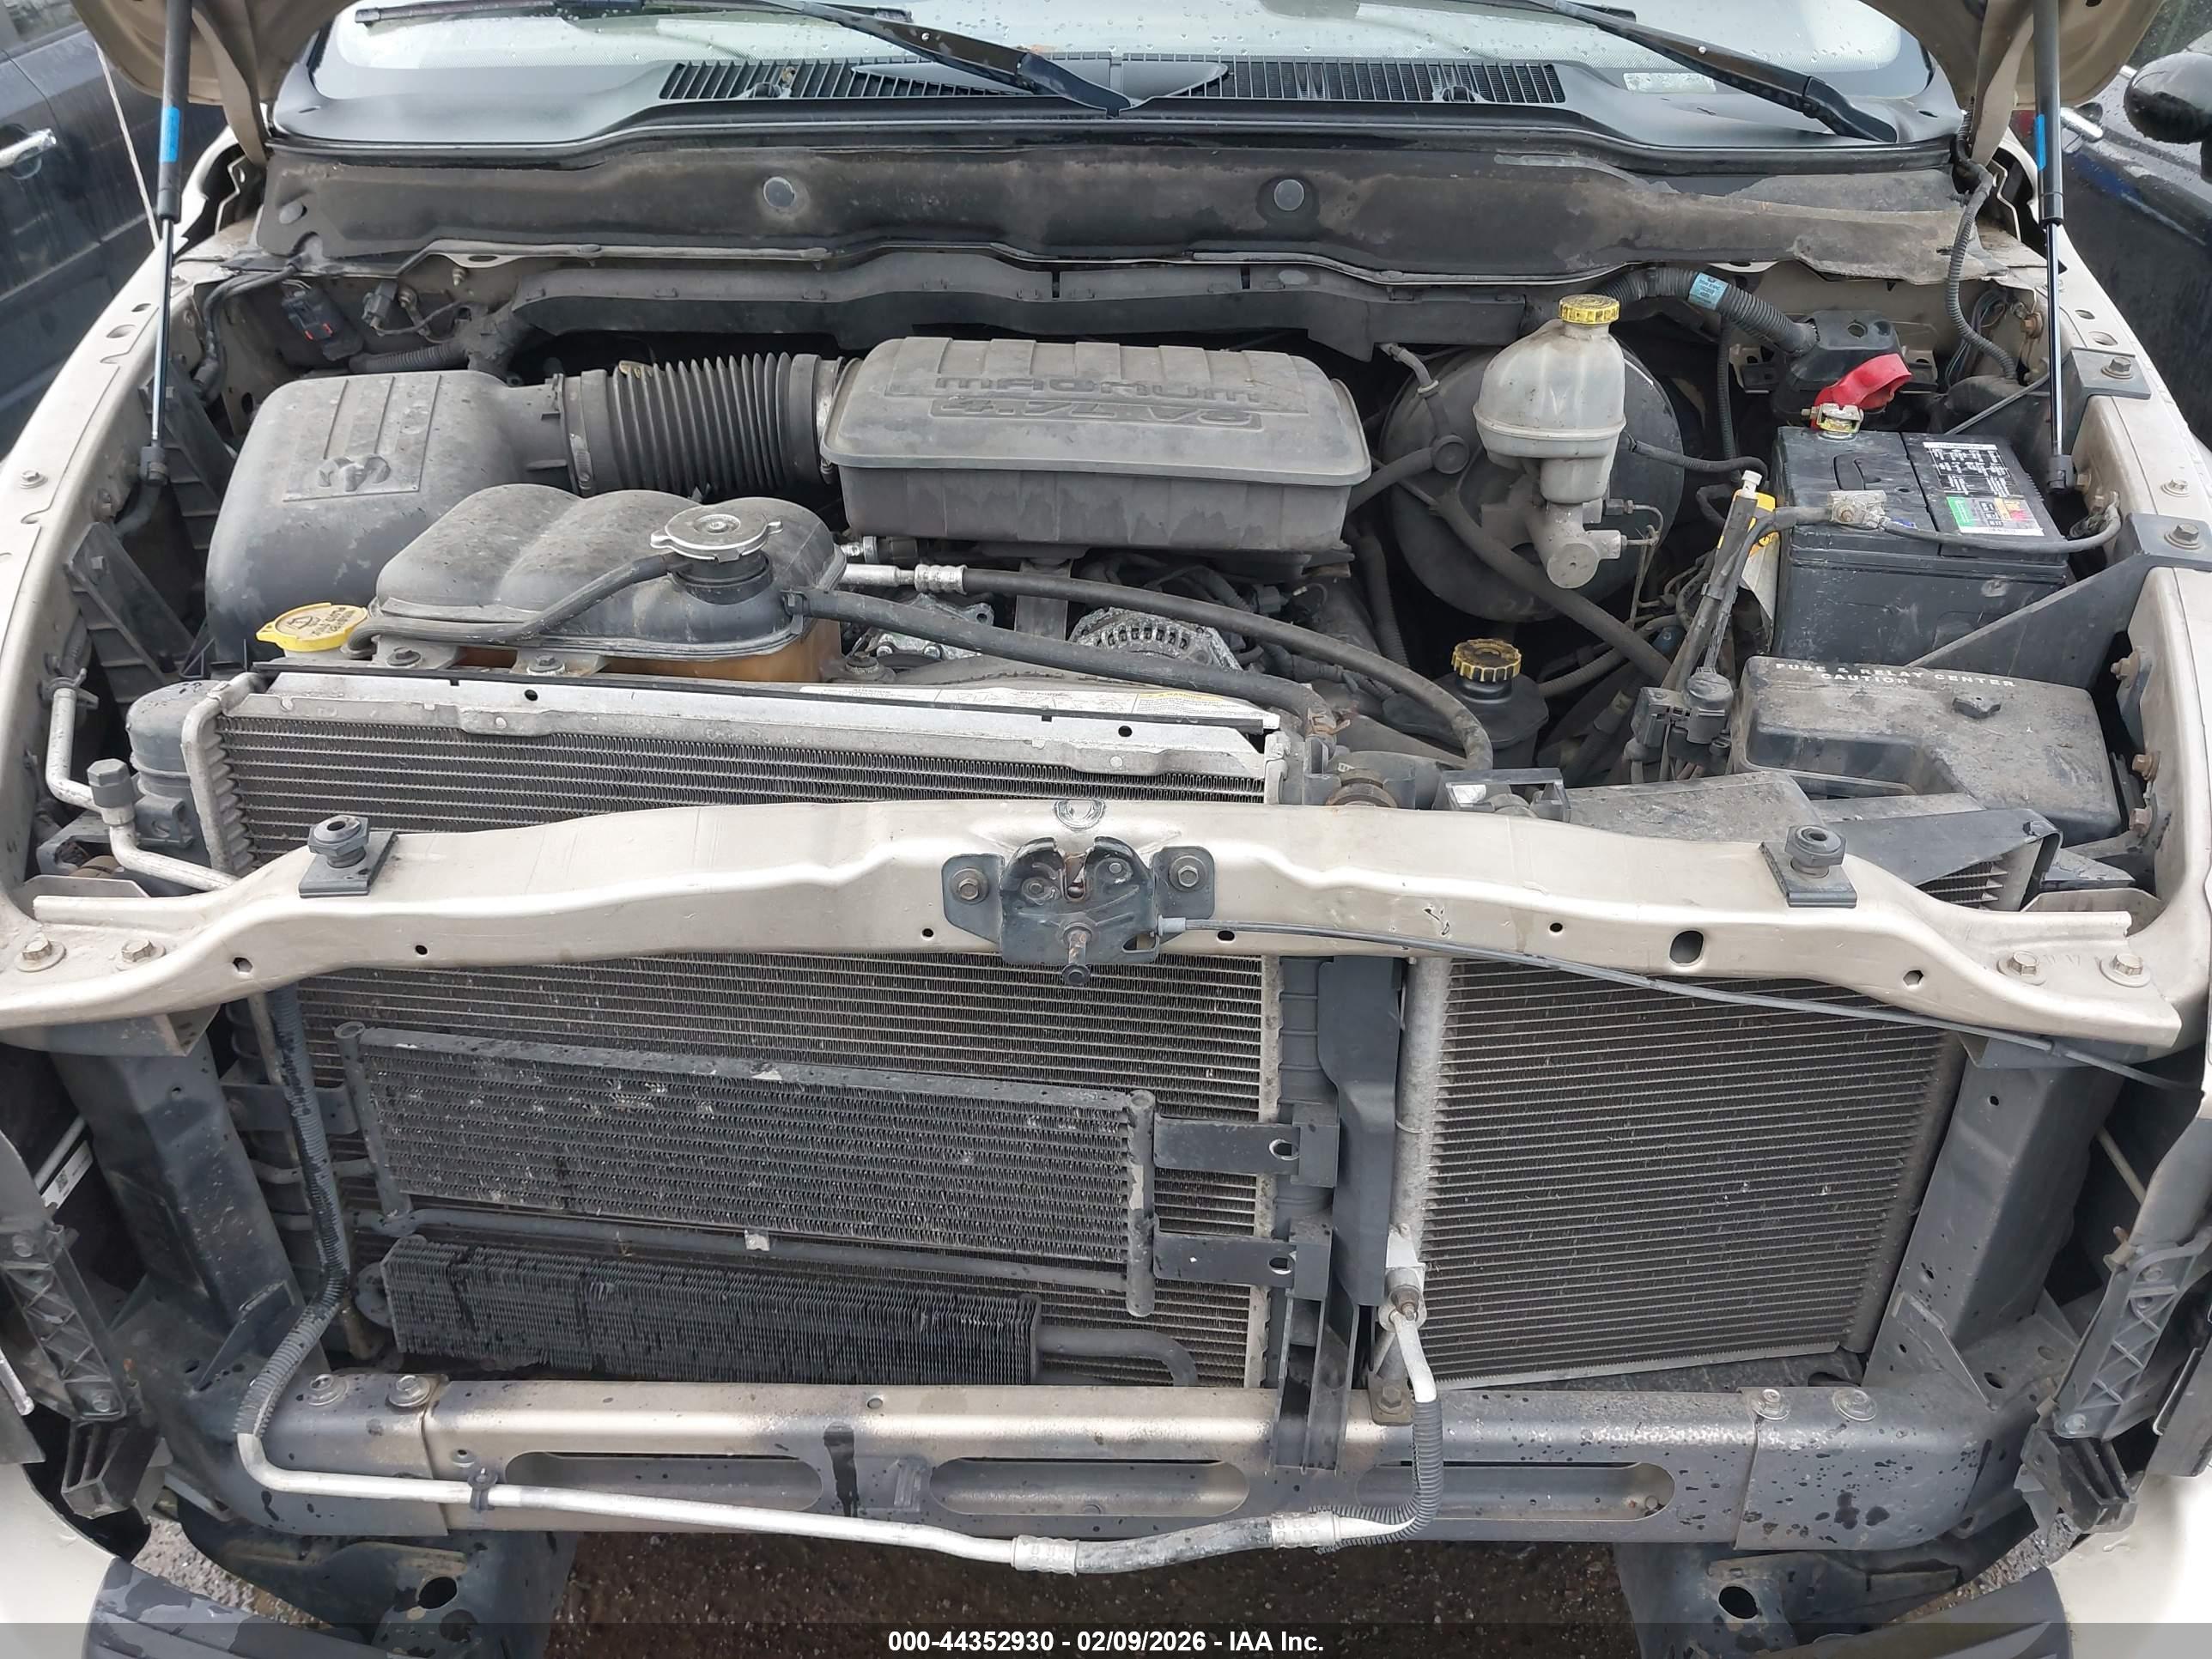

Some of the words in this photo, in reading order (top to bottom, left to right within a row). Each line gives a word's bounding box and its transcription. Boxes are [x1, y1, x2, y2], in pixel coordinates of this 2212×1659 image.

[1775, 663, 1827, 673] FUSE
[1860, 669, 1924, 678] RELAY
[1934, 674, 2016, 688] CENTER
[1820, 673, 1909, 685] CAUTION
